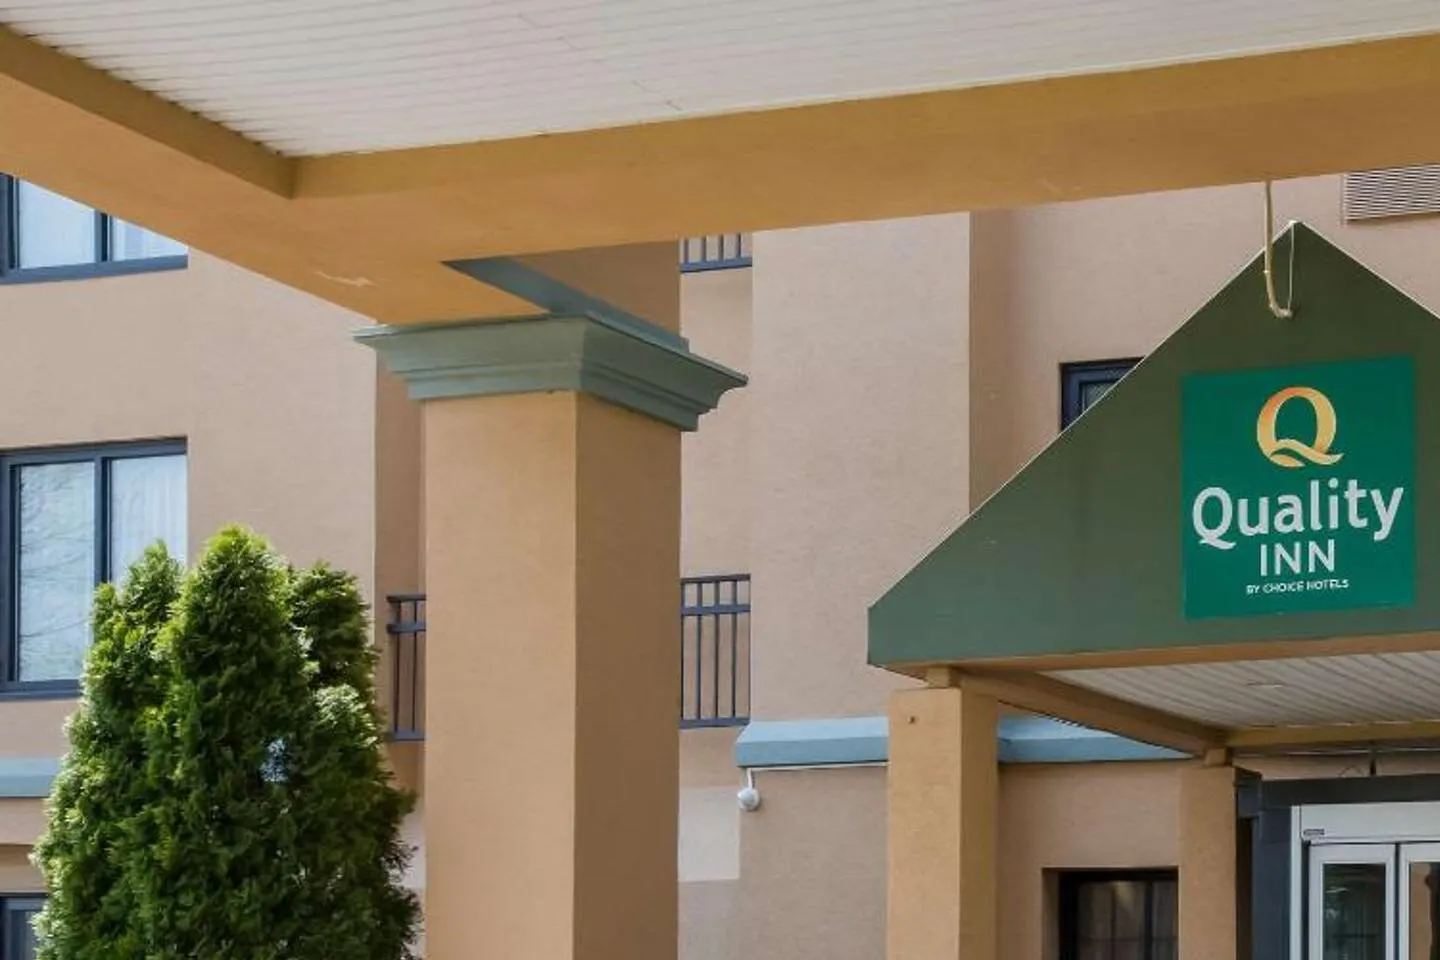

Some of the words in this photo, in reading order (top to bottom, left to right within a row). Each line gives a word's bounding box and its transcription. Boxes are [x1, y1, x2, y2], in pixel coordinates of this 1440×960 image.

[1256, 386, 1345, 468] Q
[1192, 477, 1404, 550] Quality
[1259, 539, 1336, 577] INN
[1246, 584, 1260, 595] BY
[1262, 581, 1304, 594] CHOICE
[1306, 579, 1349, 591] HOTELS
